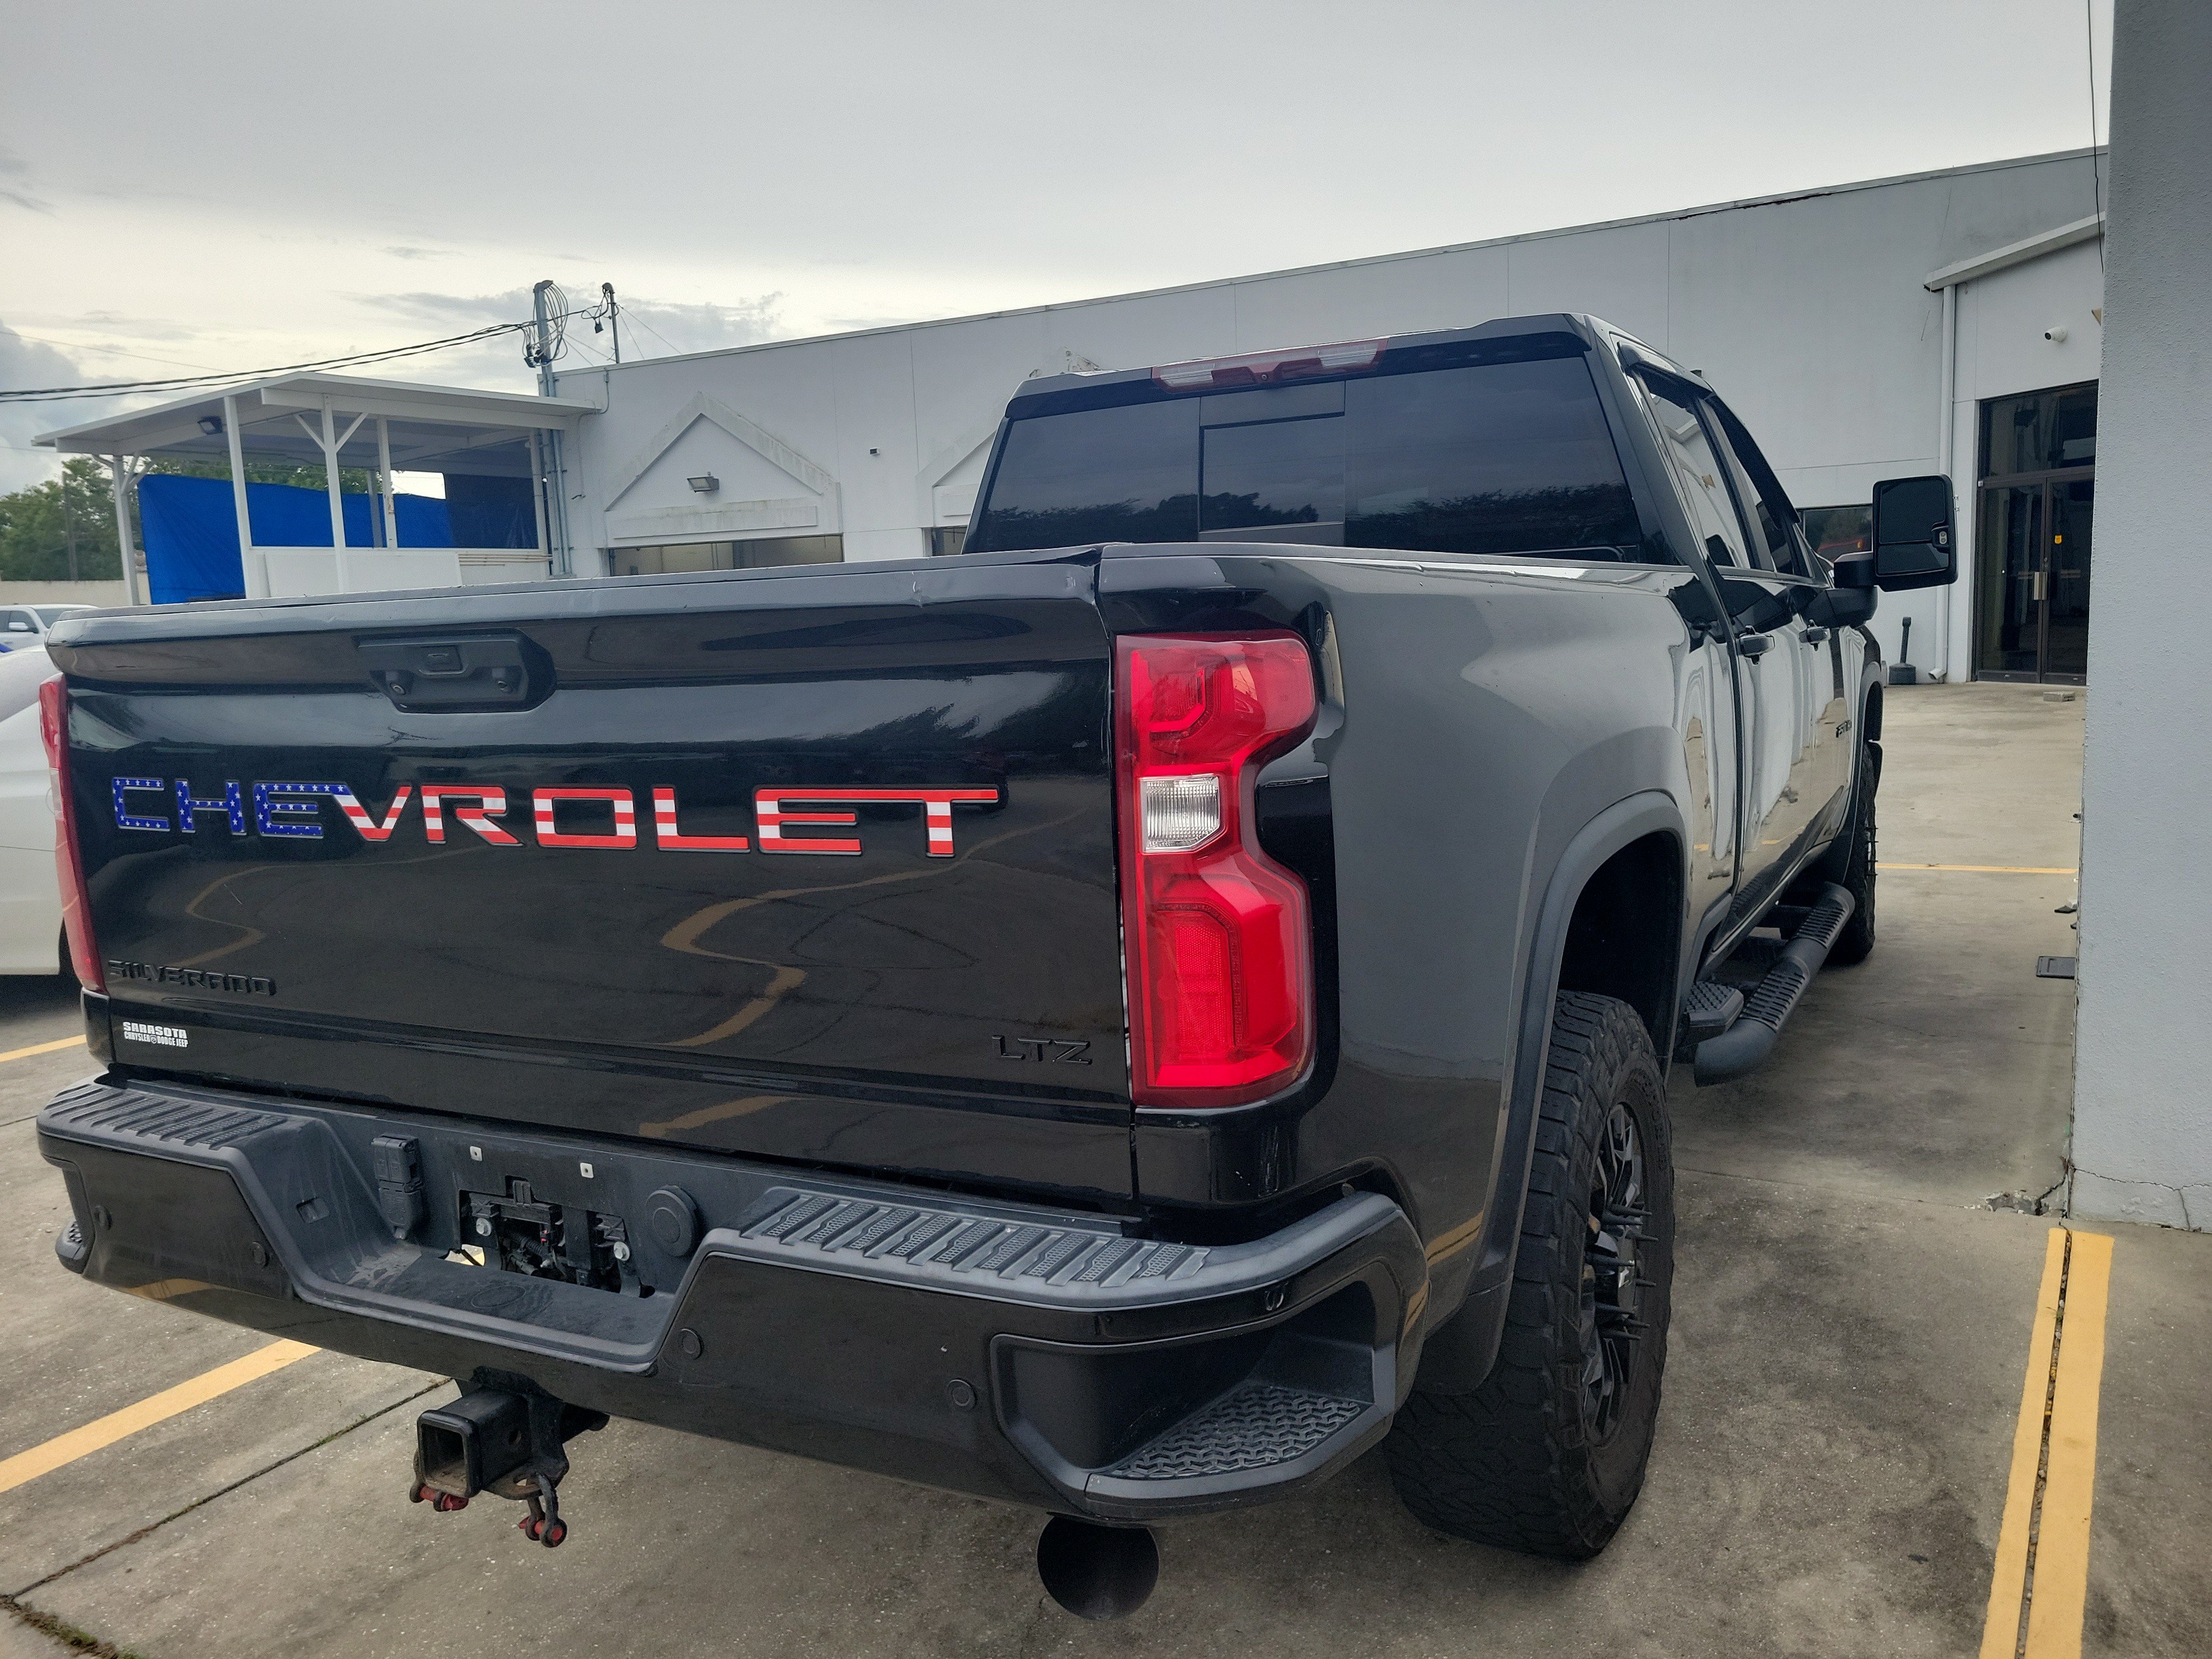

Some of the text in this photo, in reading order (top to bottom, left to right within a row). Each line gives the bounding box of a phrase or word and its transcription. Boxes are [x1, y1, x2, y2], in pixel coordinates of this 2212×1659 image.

[112, 777, 998, 857] CHEVROLET
[109, 960, 276, 995] SILVERADO
[123, 1022, 187, 1039] SARASOTA
[124, 1031, 188, 1047] CHRYSLER DODGE JEEP
[992, 1035, 1093, 1064] LTZ
